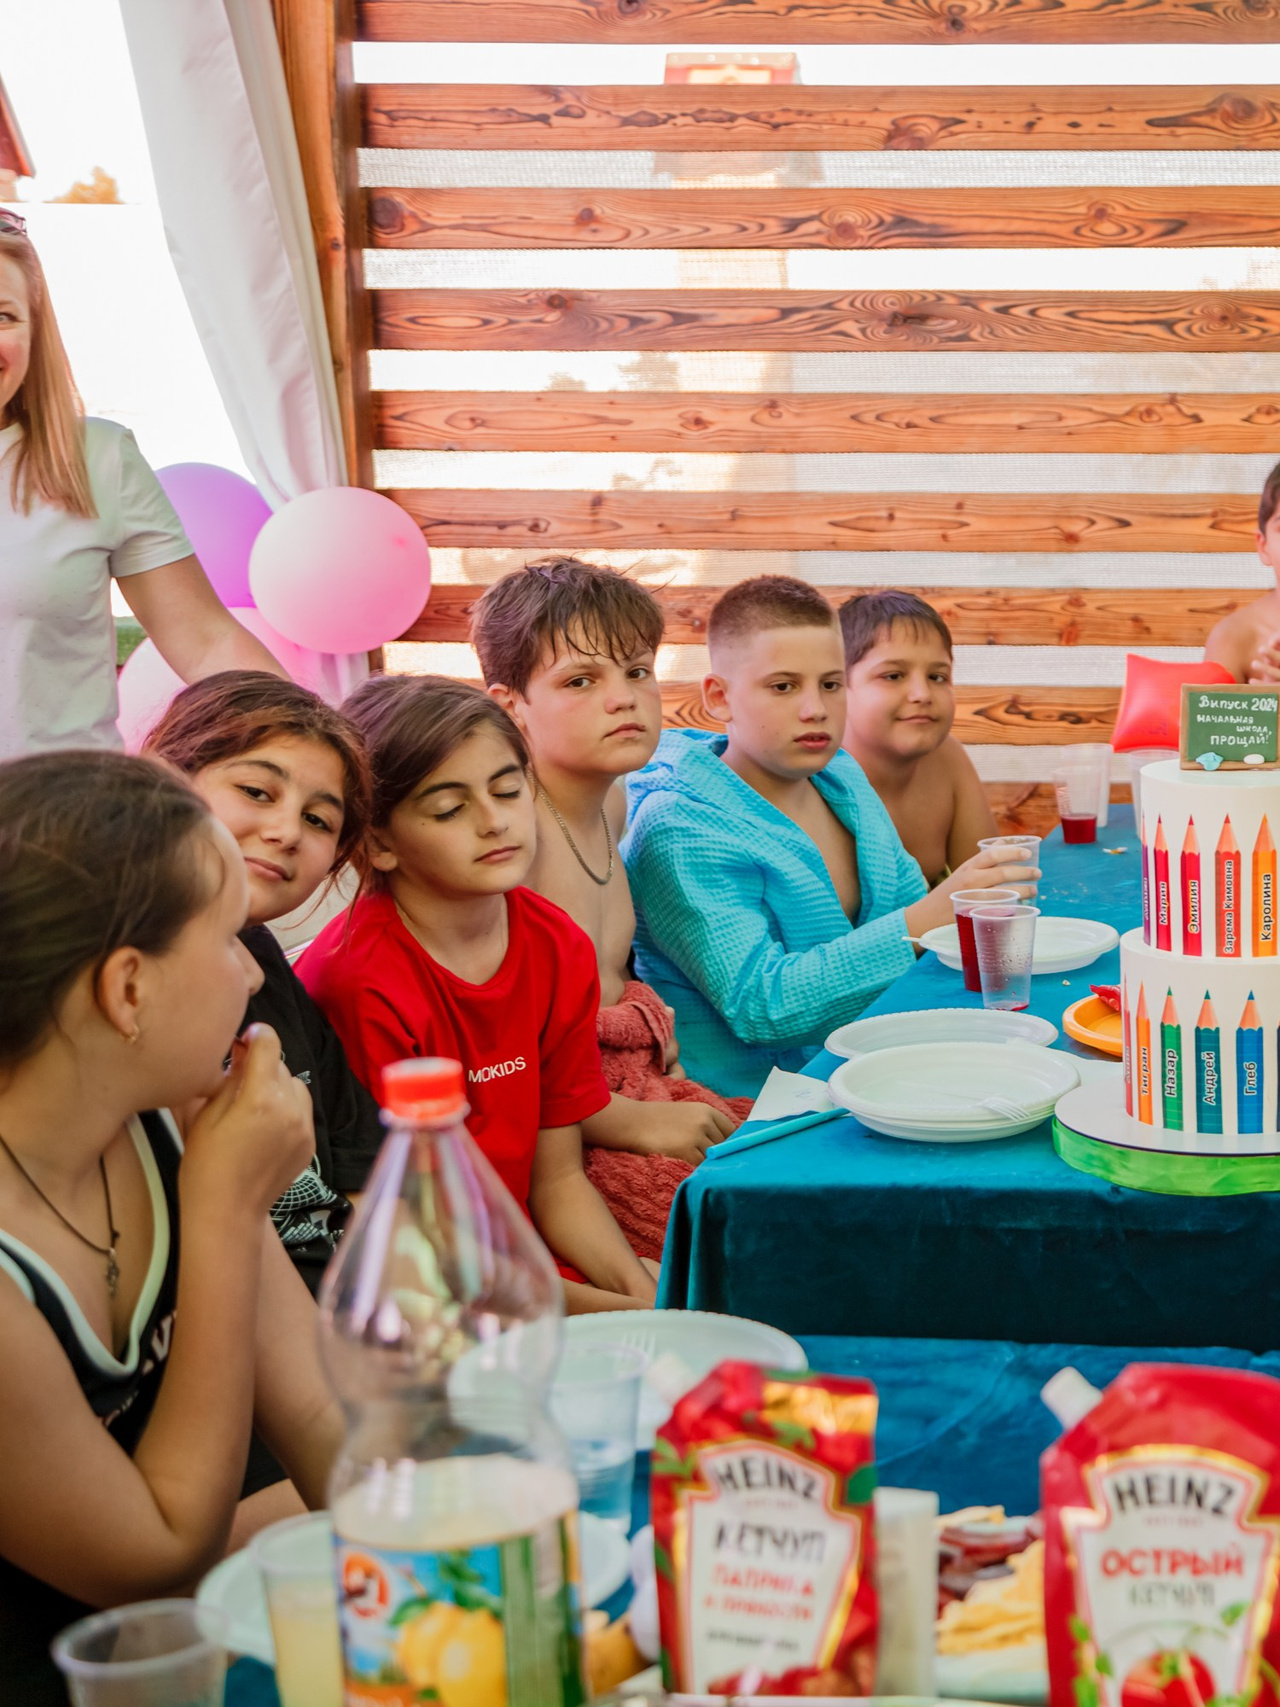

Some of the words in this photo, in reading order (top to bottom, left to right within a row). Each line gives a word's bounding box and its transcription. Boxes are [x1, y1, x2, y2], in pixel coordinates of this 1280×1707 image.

[1196, 714, 1254, 724] НАЧАЛЬНАЯ
[1198, 695, 1248, 710] Выпуск
[1250, 698, 1278, 712] 2024
[1210, 733, 1269, 747] ПРОЩАЙ!
[1159, 882, 1168, 926] Мария
[1223, 860, 1234, 910] Кимовна
[1188, 880, 1199, 934] Эмилия
[1260, 873, 1272, 942] Каролина
[1223, 911, 1234, 954] Зарема
[1141, 1046, 1149, 1097] Тигран
[1165, 1049, 1178, 1098] Назар
[1202, 1050, 1216, 1106] Андрей
[1243, 1061, 1257, 1097] Глеб
[713, 1453, 818, 1499] HEINZ
[1113, 1473, 1236, 1516] HEINZ
[715, 1522, 827, 1564] КЕТЧУП
[1101, 1541, 1244, 1578] ОСТРЫЙ
